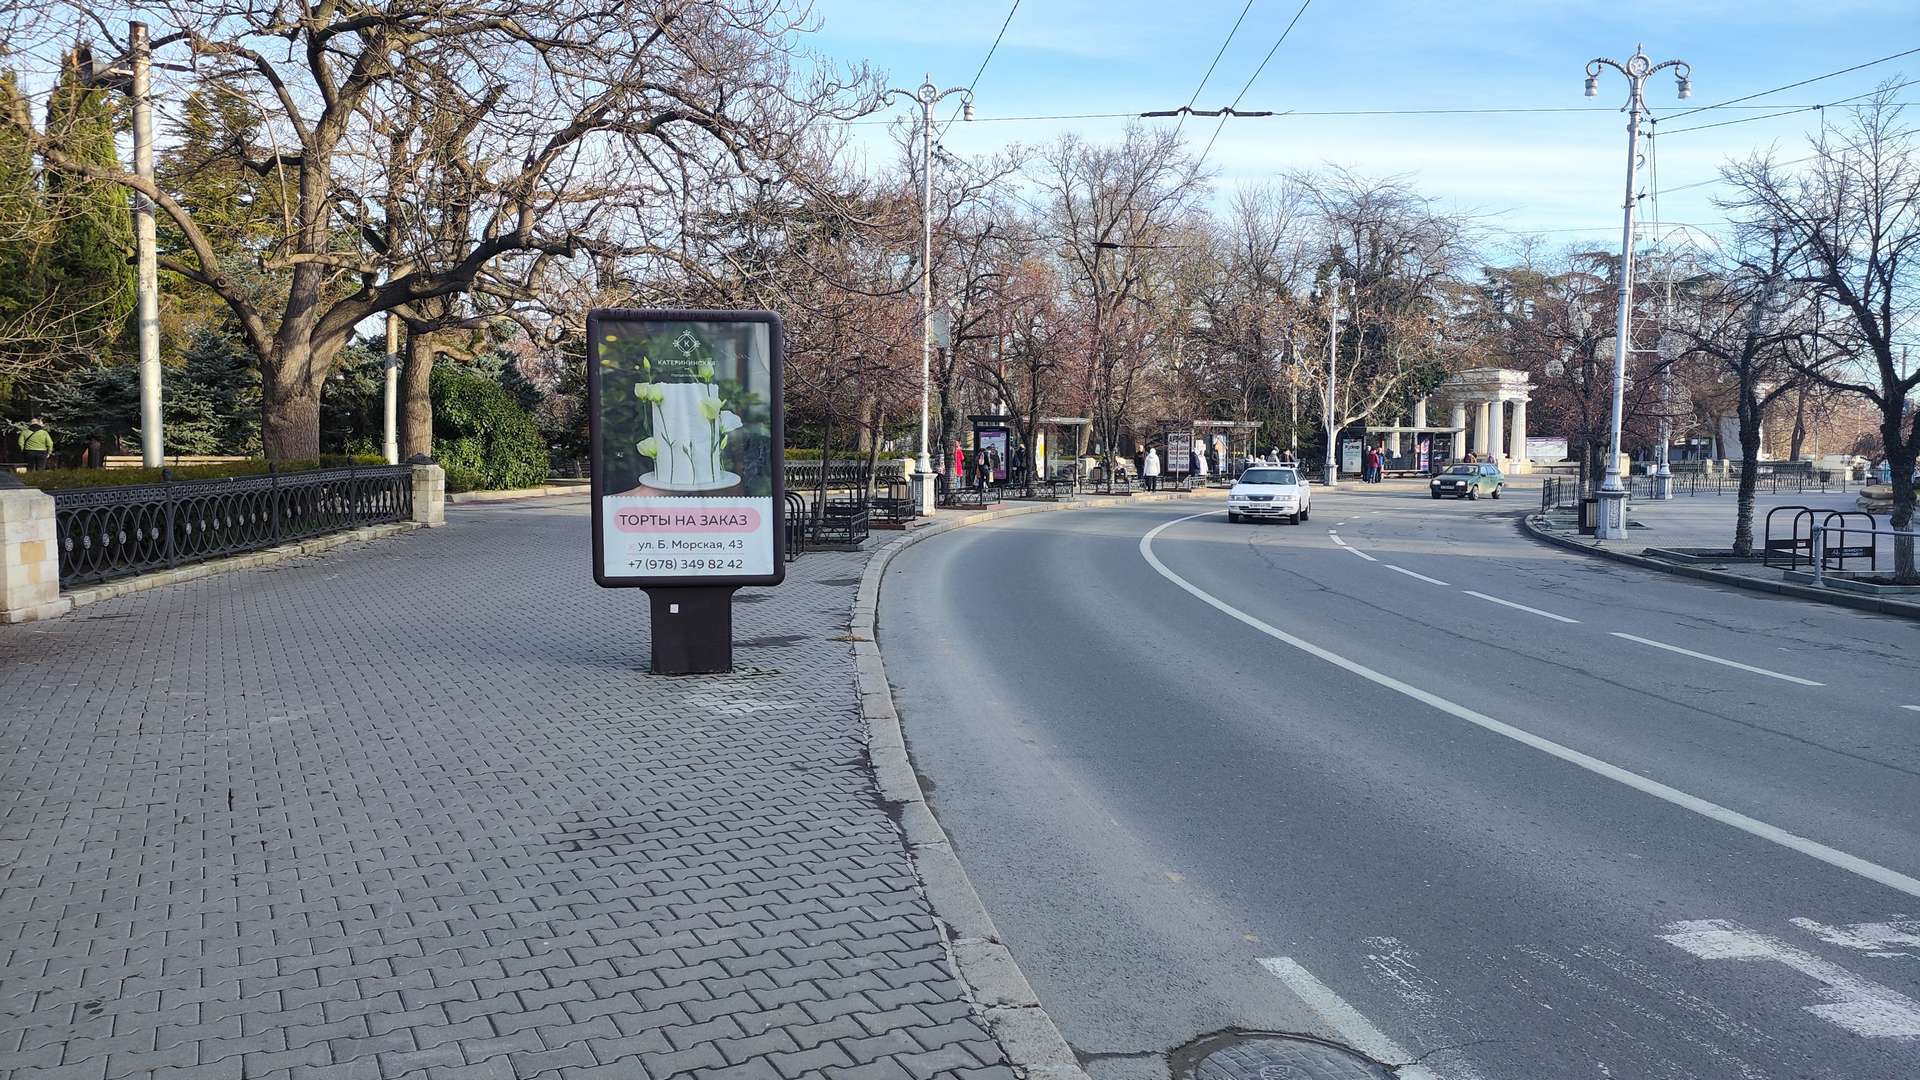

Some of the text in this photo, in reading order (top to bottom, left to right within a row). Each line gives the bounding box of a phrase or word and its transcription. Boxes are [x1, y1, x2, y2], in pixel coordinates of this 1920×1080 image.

[619, 514, 748, 526] ТОРТЫ НА ЗАКАЗ
[638, 539, 744, 551] ул. Б. Морская, 43
[628, 558, 743, 570] +7 (978) 349 82 42
